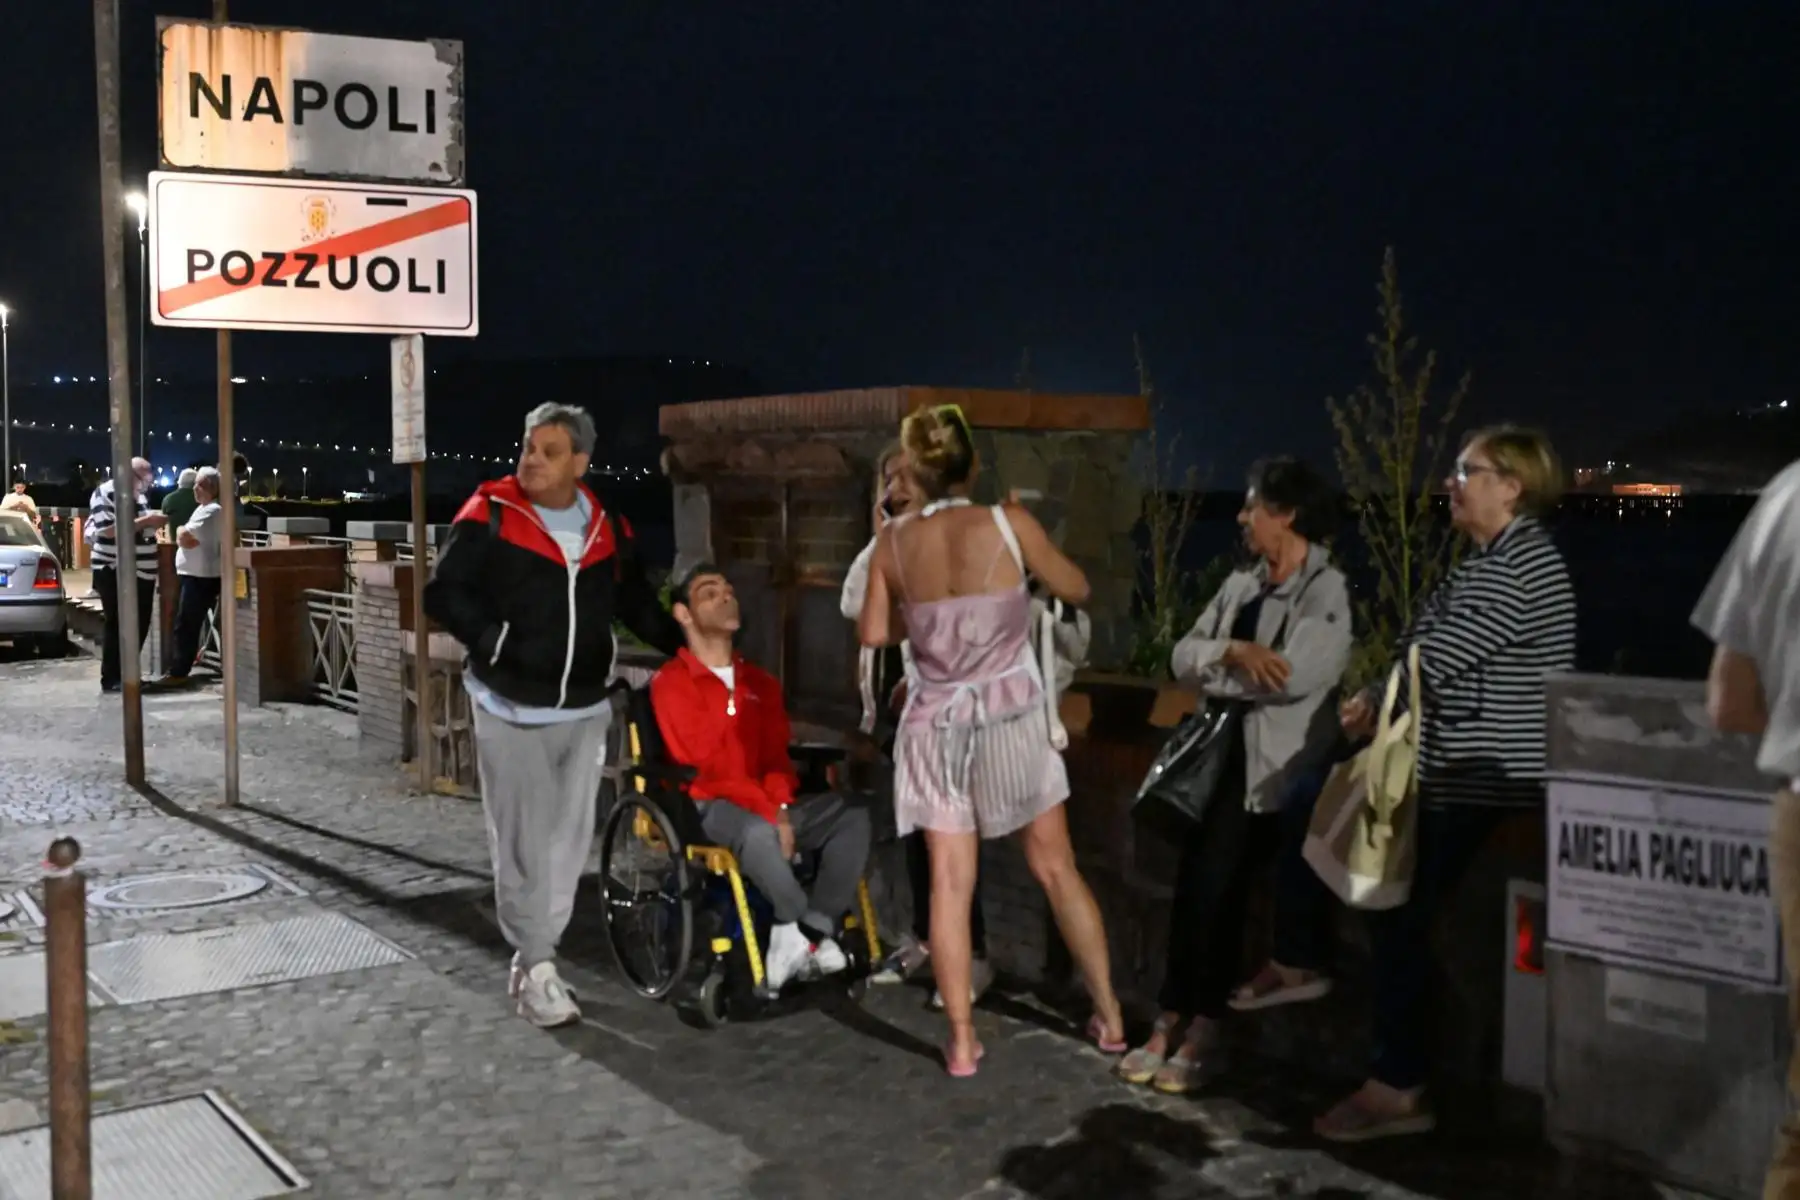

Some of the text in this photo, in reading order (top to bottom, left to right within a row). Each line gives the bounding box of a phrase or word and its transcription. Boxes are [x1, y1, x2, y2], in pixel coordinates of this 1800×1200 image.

[188, 72, 436, 134] NAPOLI
[186, 248, 446, 294] POZZUOLI
[1558, 820, 1770, 898] AMELIA PAGLIUCA
